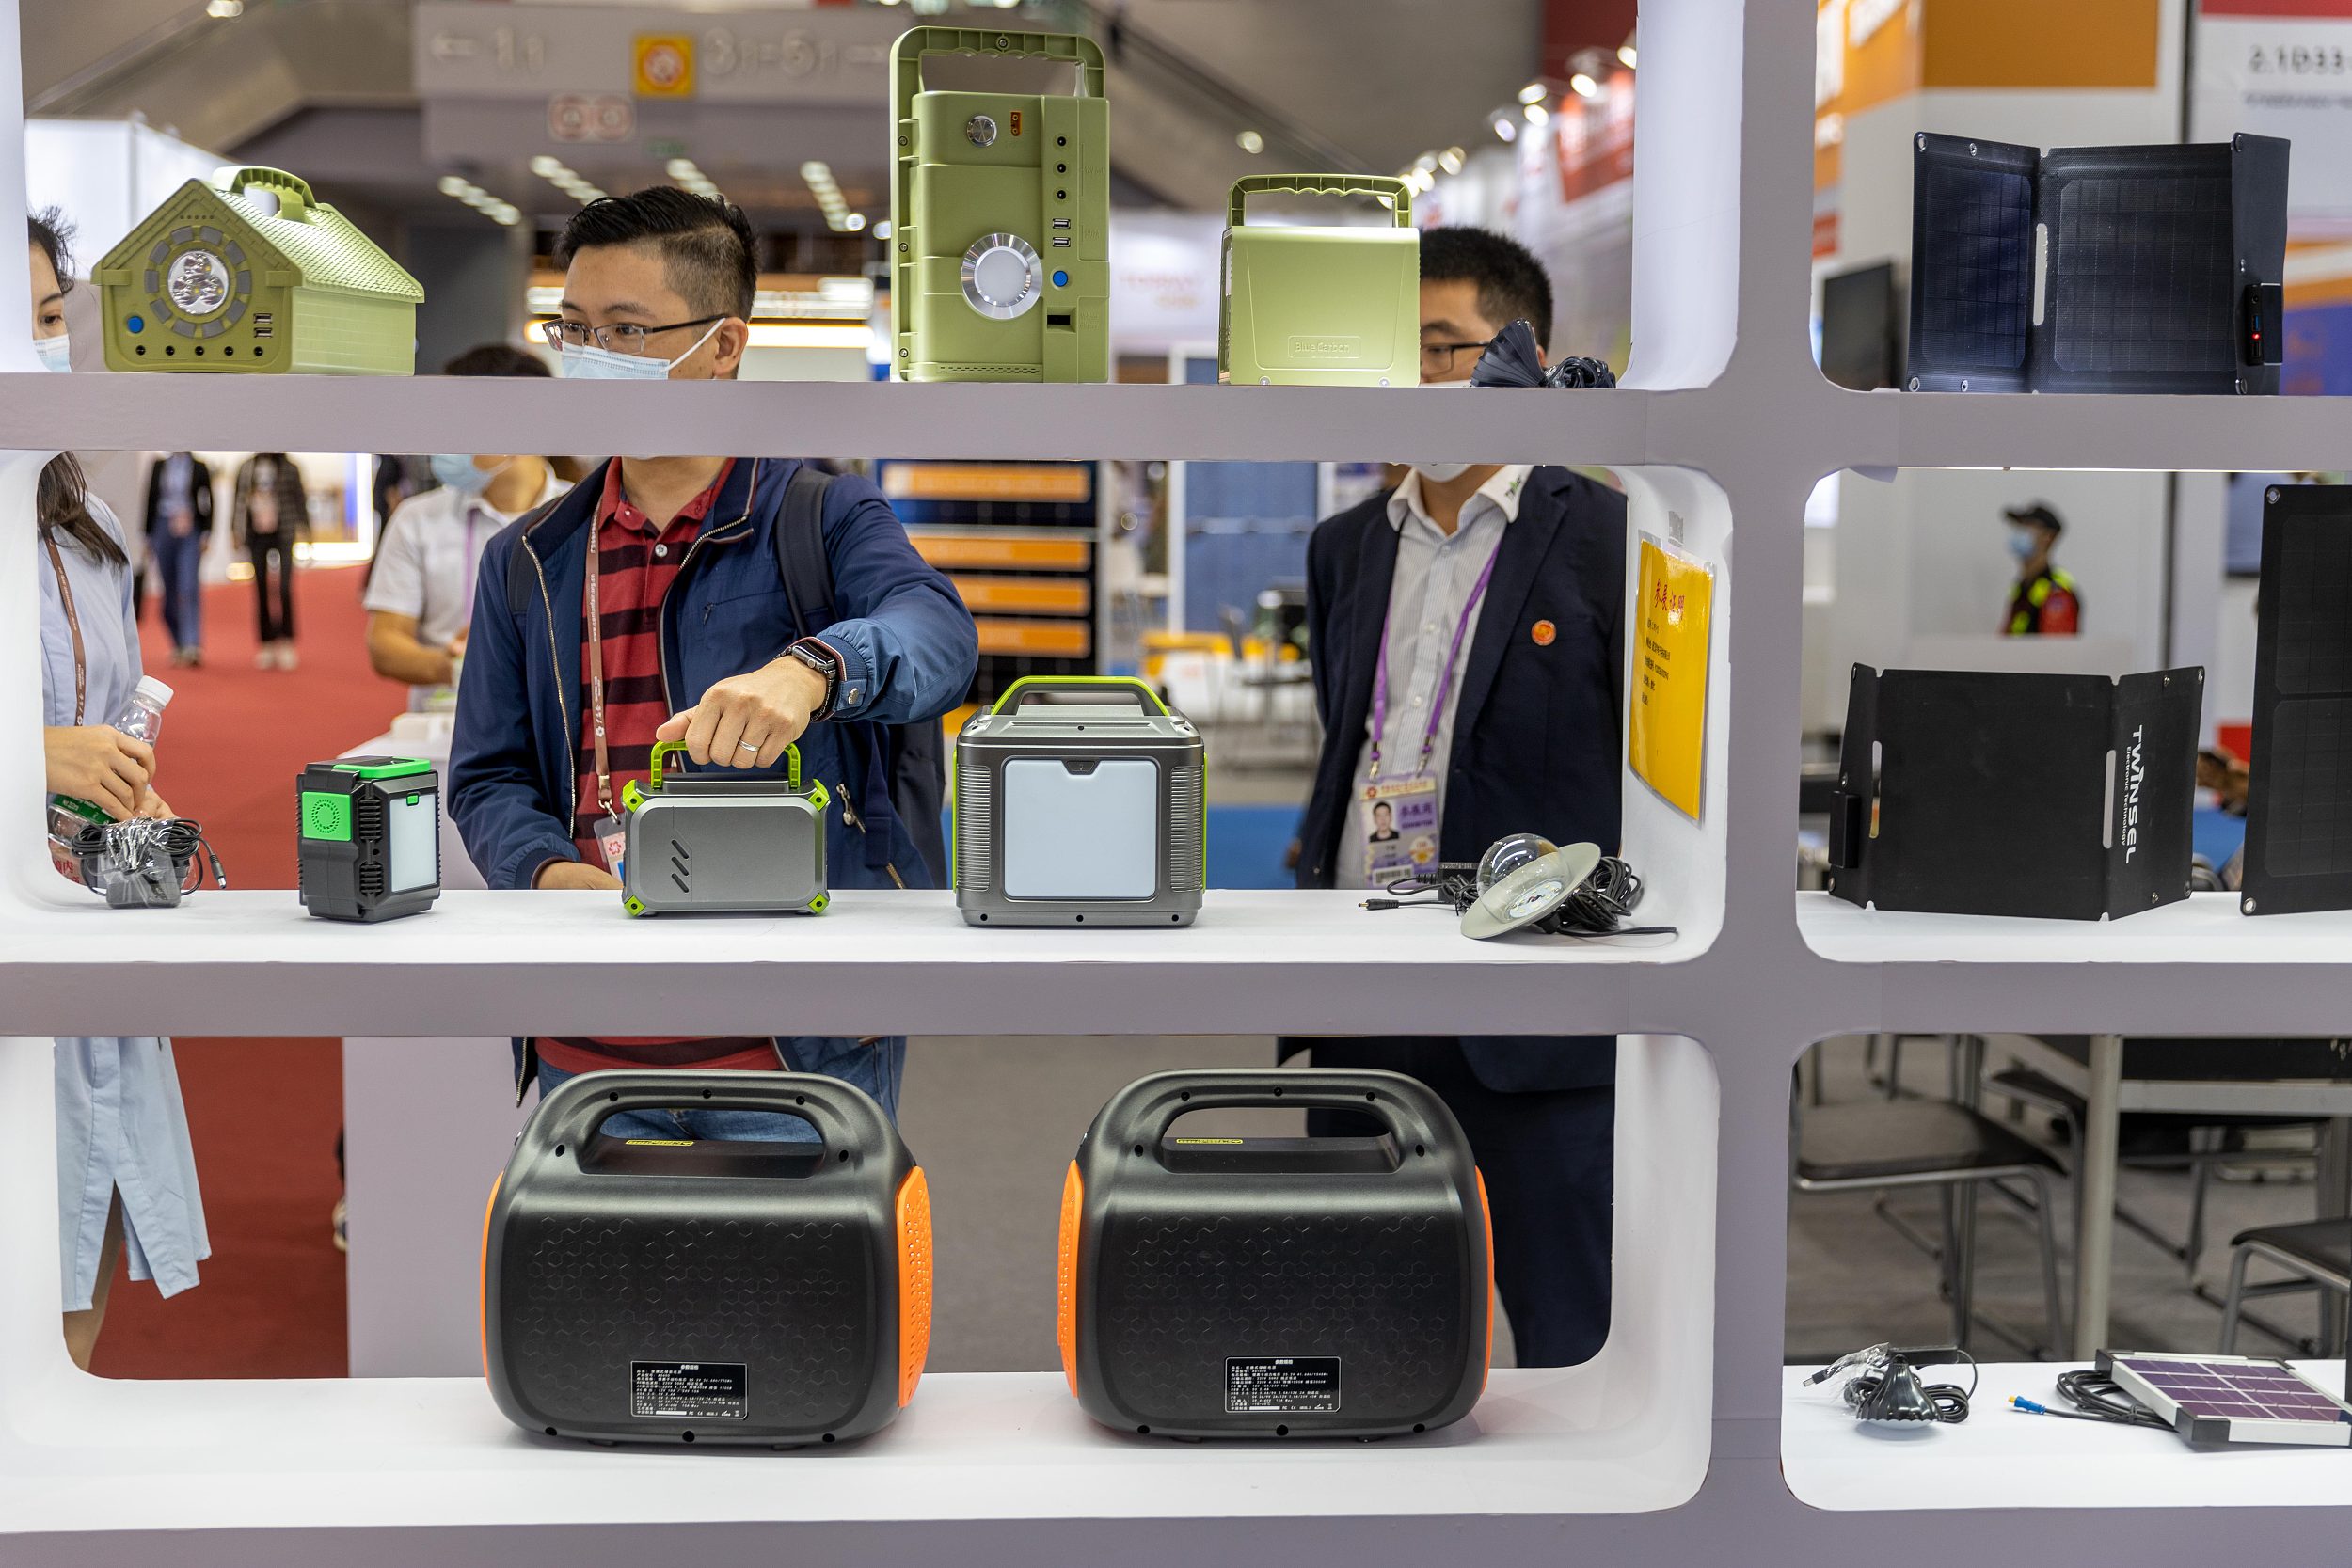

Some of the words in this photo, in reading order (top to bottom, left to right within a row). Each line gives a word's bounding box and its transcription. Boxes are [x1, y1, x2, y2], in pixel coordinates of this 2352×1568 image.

[1295, 341, 1316, 353] Blue
[1317, 341, 1350, 353] Carbon
[2121, 792, 2130, 847] Technology
[2125, 724, 2145, 864] TWINSEL
